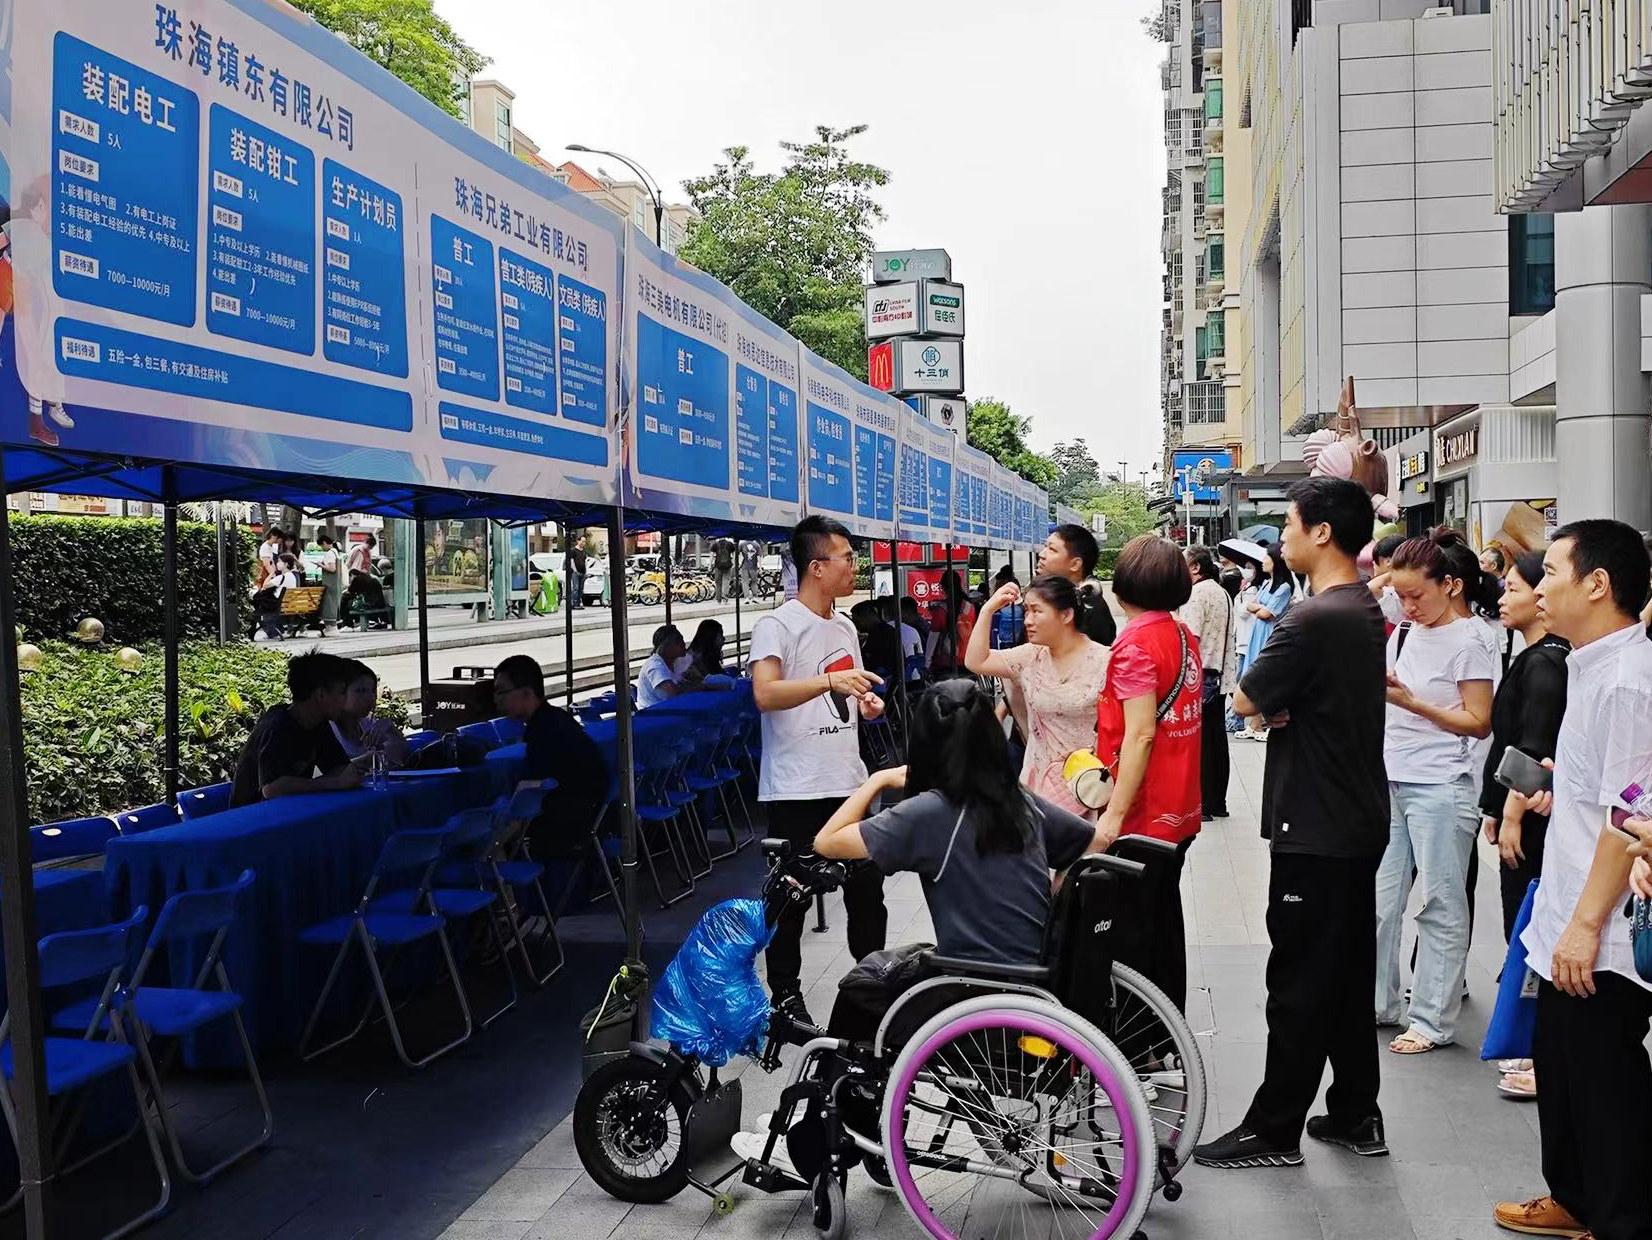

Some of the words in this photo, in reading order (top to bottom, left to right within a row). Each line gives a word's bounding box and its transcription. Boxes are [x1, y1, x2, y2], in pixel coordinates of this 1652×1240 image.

[155, 4, 354, 151] 珠海镇东有限公司
[82, 61, 176, 133] 装配电工
[64, 115, 95, 137] 需求人数
[107, 132, 121, 150] 5人
[64, 155, 94, 176] 岗位要求
[231, 128, 298, 186] 装配钳工
[332, 176, 396, 232] 生产计划员
[455, 176, 588, 271] 珠海兄弟工业有限公司
[64, 255, 94, 274] 薪资待遇
[453, 236, 473, 266] 普工
[66, 341, 95, 358] 福利待遇
[677, 347, 693, 375] 普工
[819, 725, 839, 736] FILA
